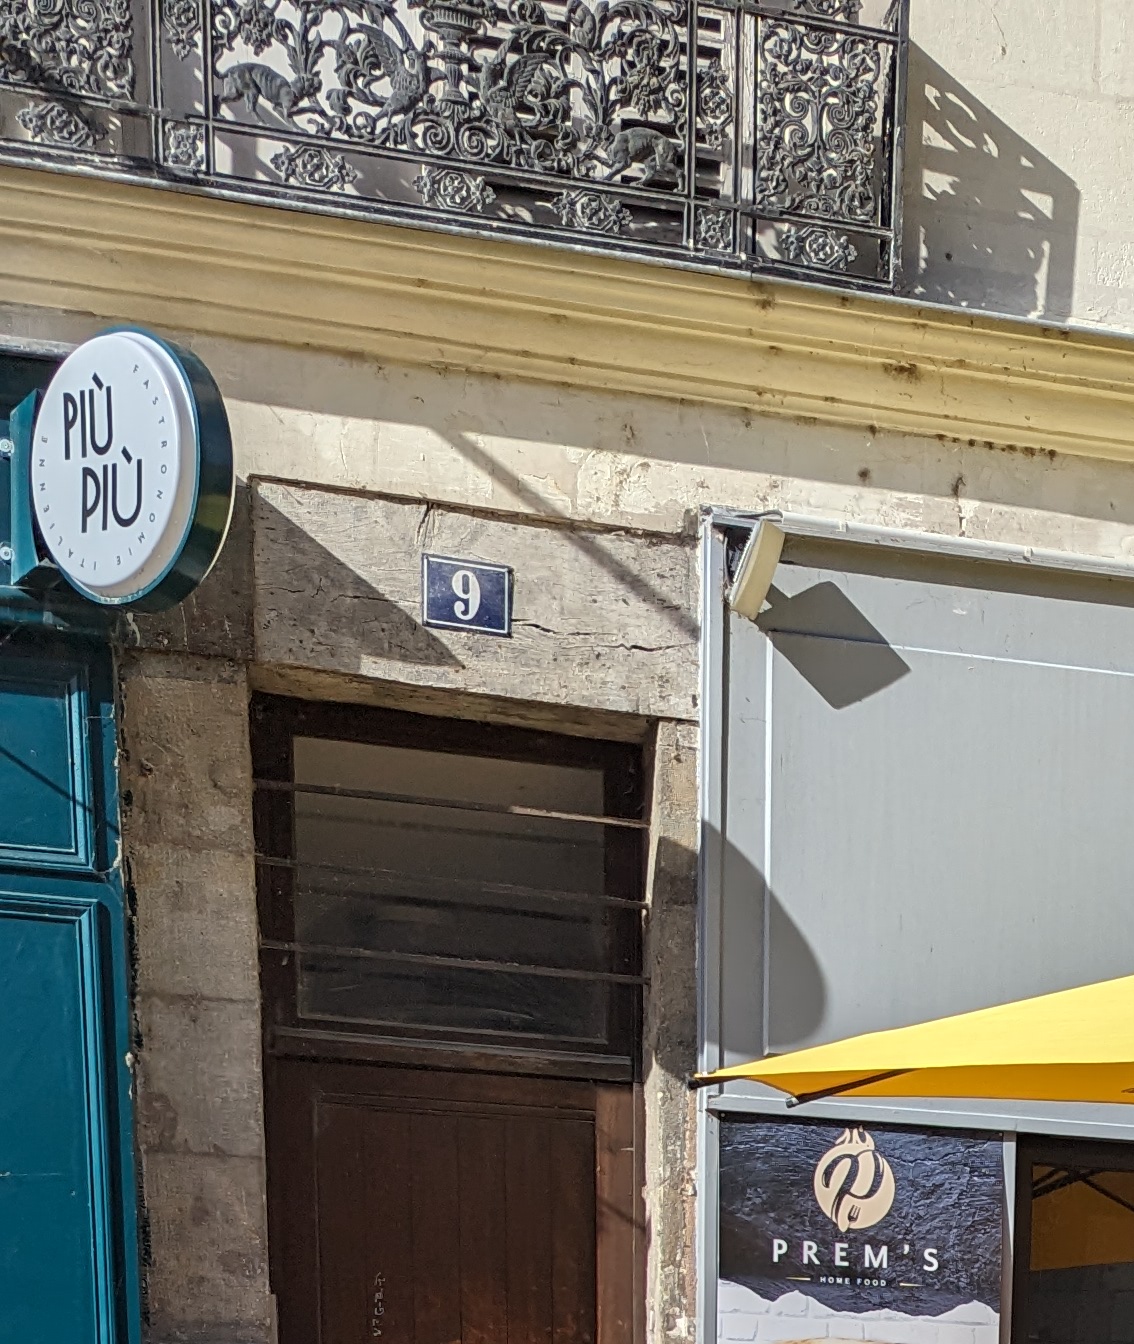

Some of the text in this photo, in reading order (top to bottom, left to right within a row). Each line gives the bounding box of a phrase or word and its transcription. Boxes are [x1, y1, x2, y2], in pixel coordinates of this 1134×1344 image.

[63, 372, 114, 460] PIÙ
[81, 446, 142, 533] PIÙ
[452, 569, 481, 620] 9
[772, 1238, 939, 1272] PREM'S
[819, 1276, 887, 1287] HOME FOOD
